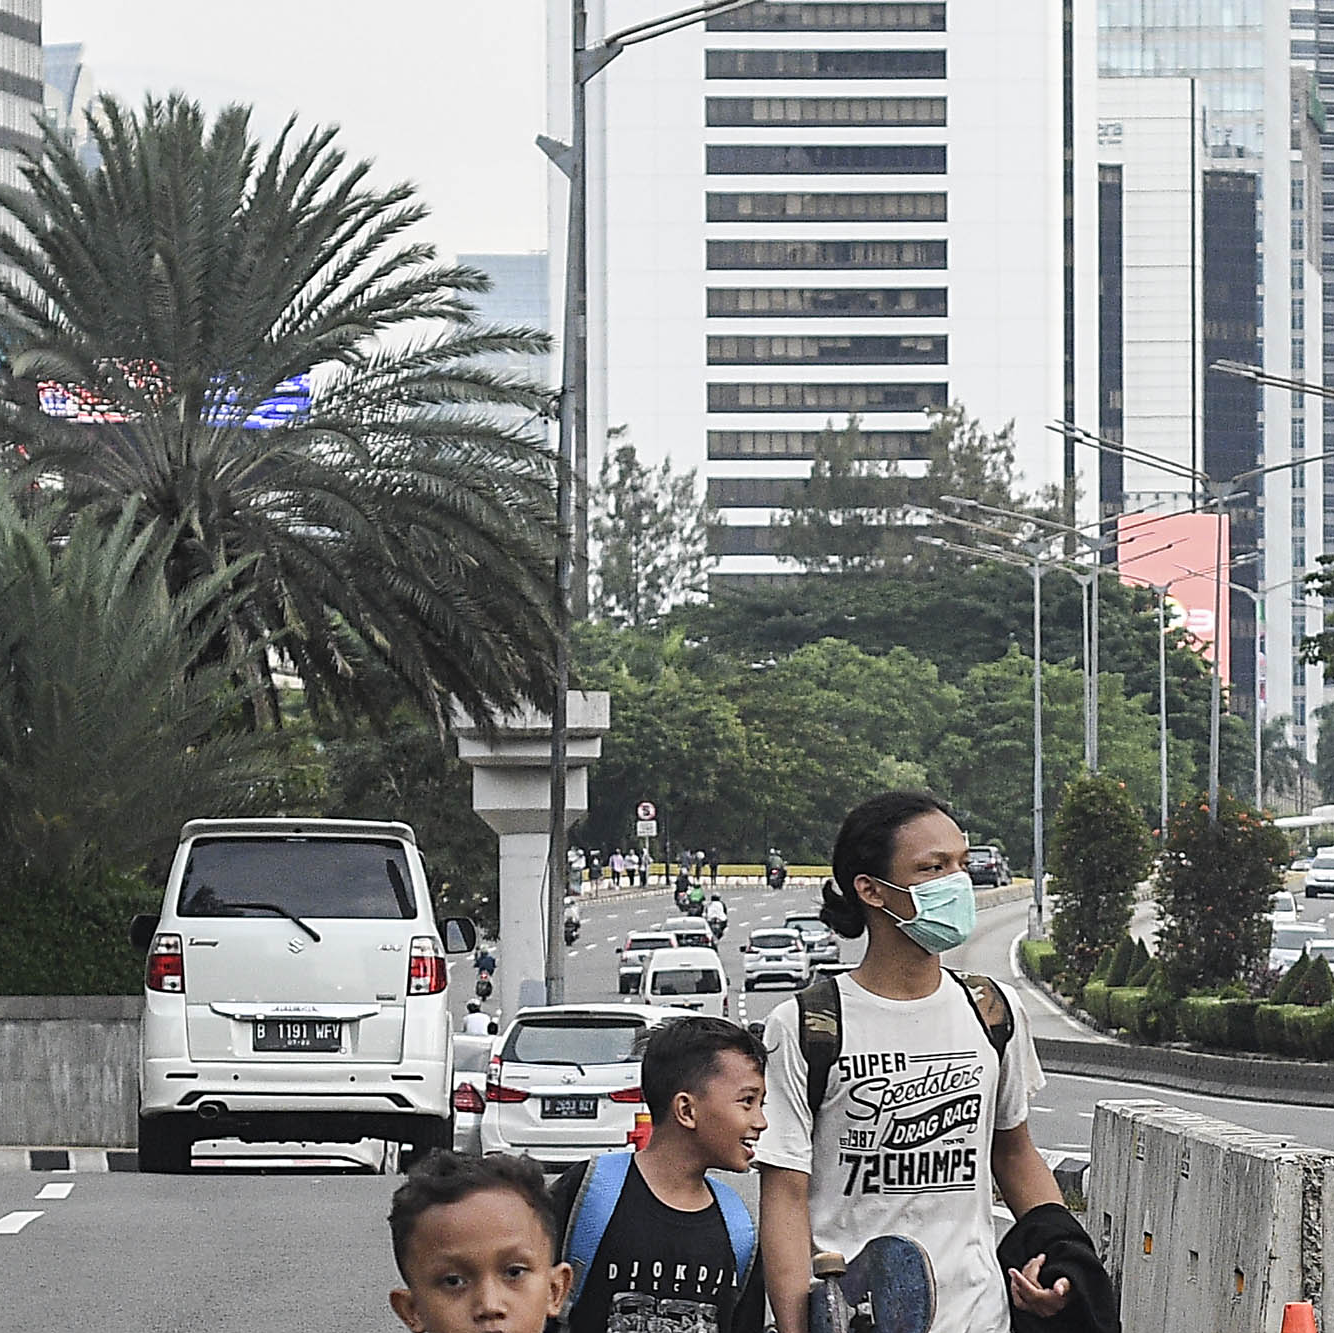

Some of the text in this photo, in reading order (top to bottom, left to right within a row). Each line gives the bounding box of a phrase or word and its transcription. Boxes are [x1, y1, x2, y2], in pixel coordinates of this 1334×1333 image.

[257, 1023, 340, 1039] B 1191 WFV
[838, 1052, 907, 1083] SUPER
[845, 1063, 984, 1126] Speedsters
[848, 1129, 877, 1148] 1987
[892, 1099, 979, 1144] DRAG RACE
[883, 1148, 978, 1186] CHAMPS
